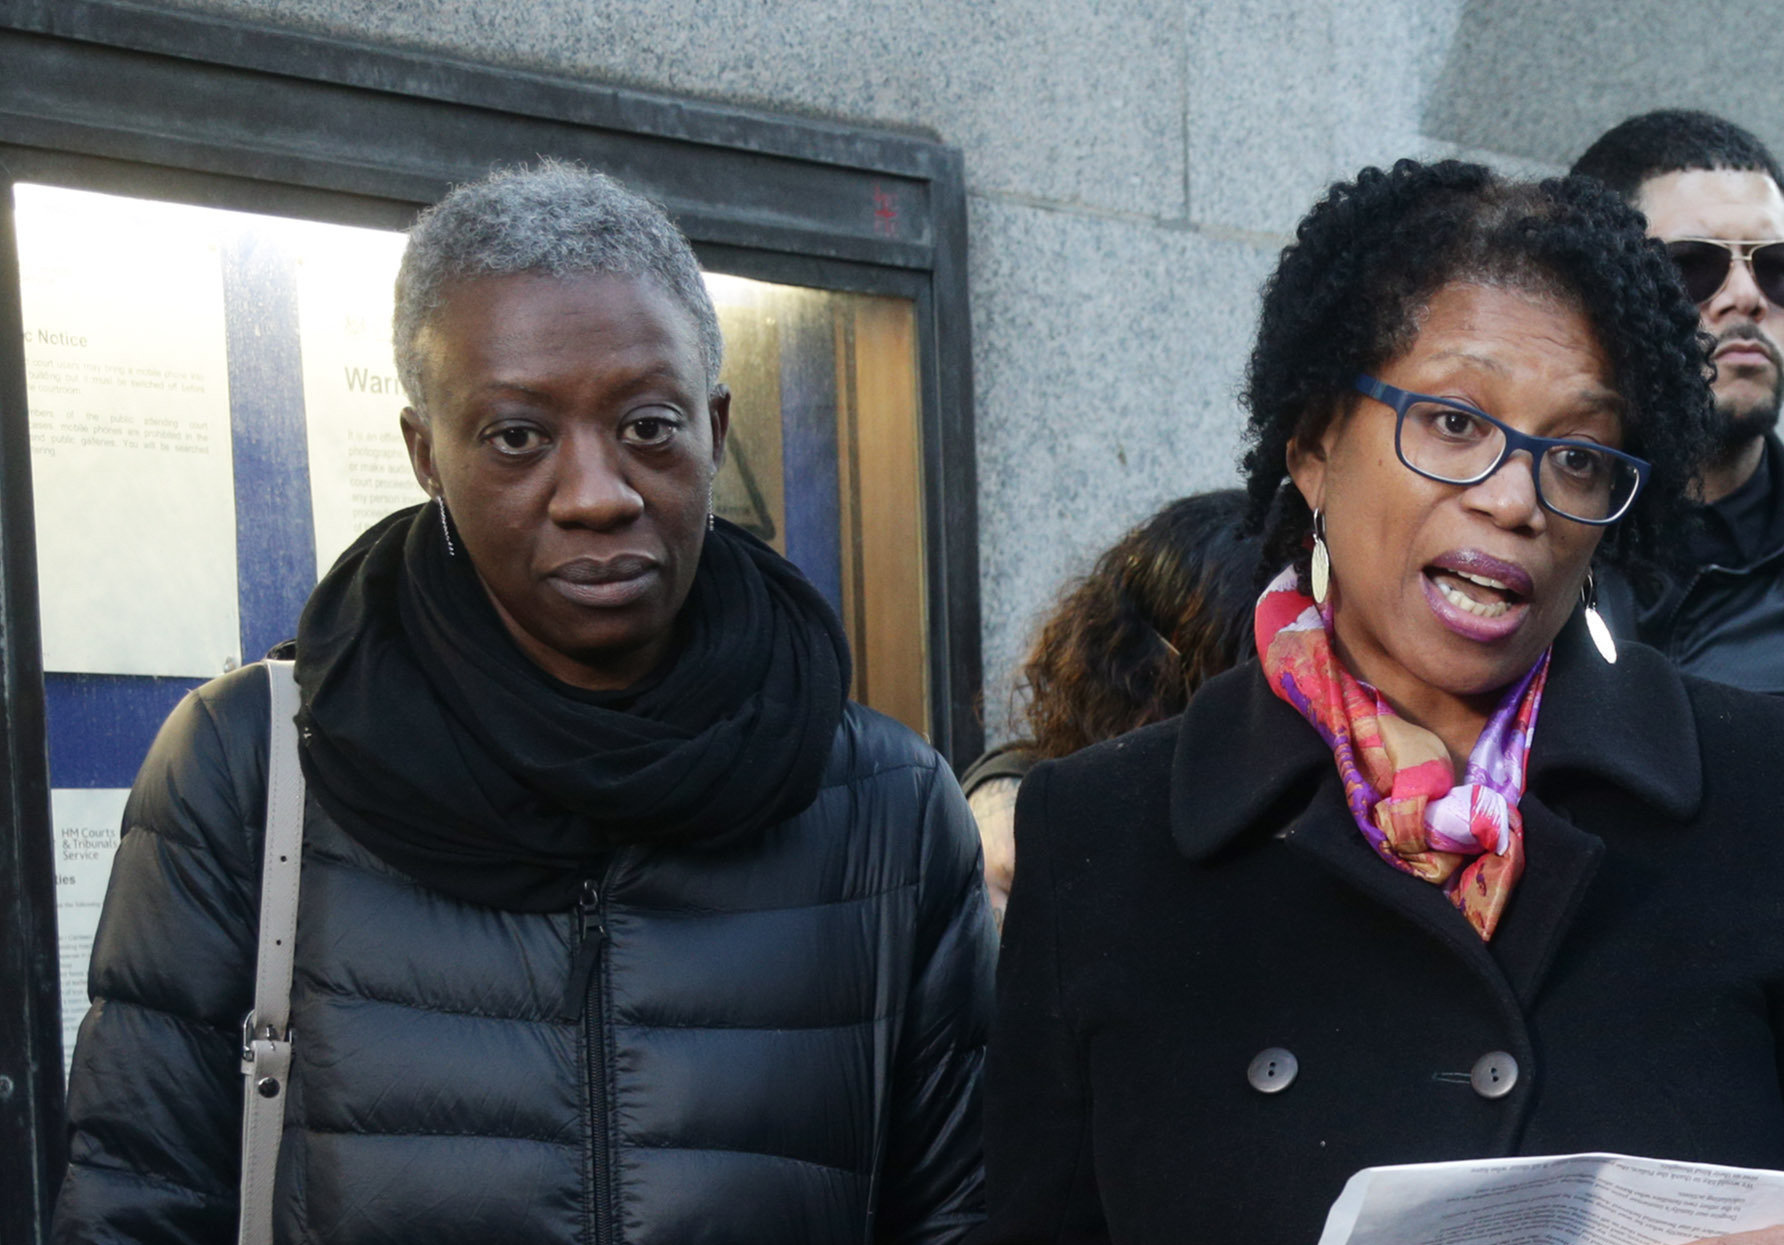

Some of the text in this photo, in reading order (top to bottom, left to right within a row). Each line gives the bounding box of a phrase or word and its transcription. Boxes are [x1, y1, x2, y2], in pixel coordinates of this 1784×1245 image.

[38, 328, 88, 348] Notice
[61, 827, 116, 839] HM Courts
[62, 839, 118, 850] & Tribunals
[63, 850, 99, 861] Service
